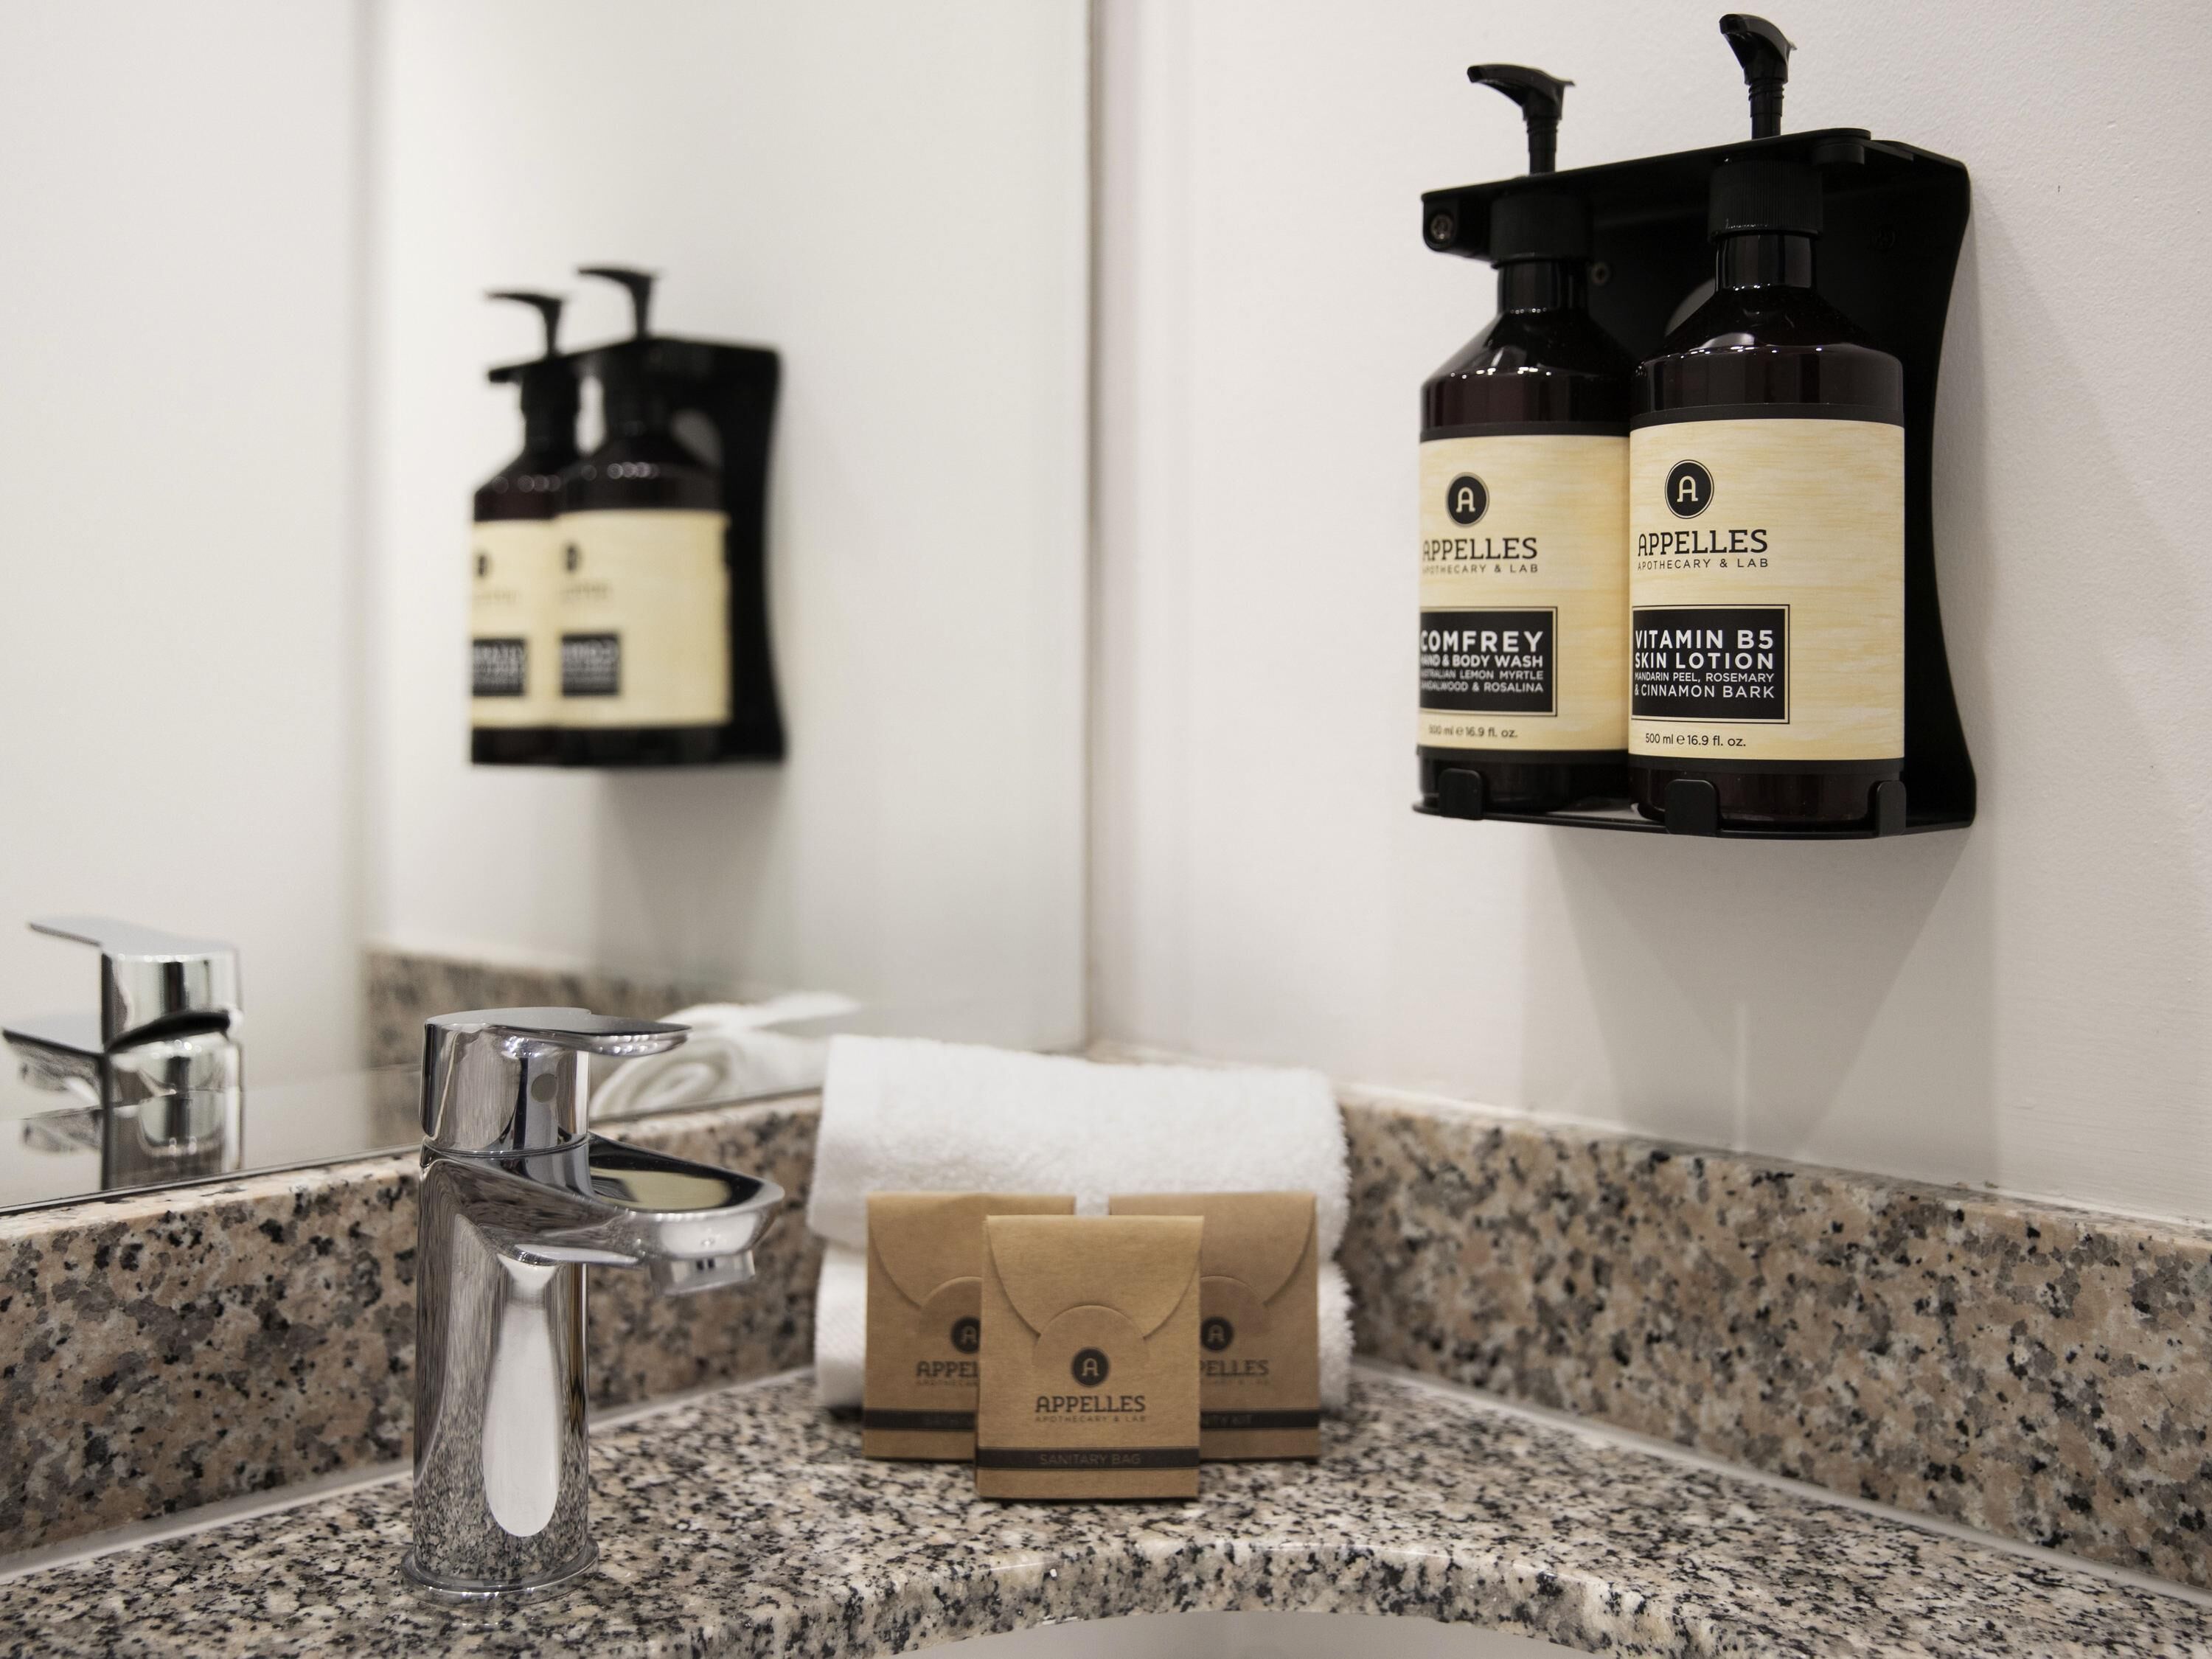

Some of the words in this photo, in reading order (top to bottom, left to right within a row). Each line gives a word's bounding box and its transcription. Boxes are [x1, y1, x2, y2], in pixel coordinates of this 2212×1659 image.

[1677, 476, 1698, 502] A
[1455, 487, 1475, 512] A
[1422, 537, 1538, 561] APPELLES
[1638, 529, 1767, 556] APPELLES
[1494, 563, 1501, 573] &
[1510, 563, 1538, 573] LAB
[1638, 559, 1711, 571] APOTHECARY
[1719, 558, 1728, 568] &
[1737, 558, 1768, 568] LAB
[1420, 630, 1543, 653] COMFREY
[1635, 630, 1723, 649] VITAMIN
[1737, 630, 1773, 649] B5
[1441, 654, 1450, 667] &
[1452, 655, 1490, 667] BODY
[1495, 655, 1543, 667] WASH
[1635, 653, 1666, 669] SKIN
[1676, 653, 1773, 669] LOTION
[1459, 669, 1494, 680] LEMON
[1500, 670, 1544, 680] MYRTLE
[1635, 672, 1669, 682] MANDARIN
[1673, 672, 1700, 683] PEEL,
[1705, 672, 1774, 683] ROSEMARY
[1472, 681, 1479, 692] &
[1484, 682, 1544, 693] ROSALINA
[1634, 684, 1639, 696] &
[1641, 684, 1715, 698] CINNAMON
[1722, 686, 1775, 698] BARK
[1488, 726, 1498, 737] fl.
[1501, 728, 1518, 738] oz.
[1645, 733, 1660, 744] 500
[1663, 734, 1674, 745] ml
[1687, 735, 1709, 746] 16.9
[1713, 735, 1724, 747] fl.
[1728, 738, 1747, 748] oz.
[916, 1360, 978, 1377] APPEL
[1035, 1395, 1147, 1413] APPELLES
[1035, 1415, 1107, 1423] APOTHECARY
[1114, 1415, 1121, 1423] &
[1125, 1415, 1147, 1423] LAB
[1040, 1454, 1107, 1465] SANITARY
[1112, 1453, 1141, 1464] BAG
